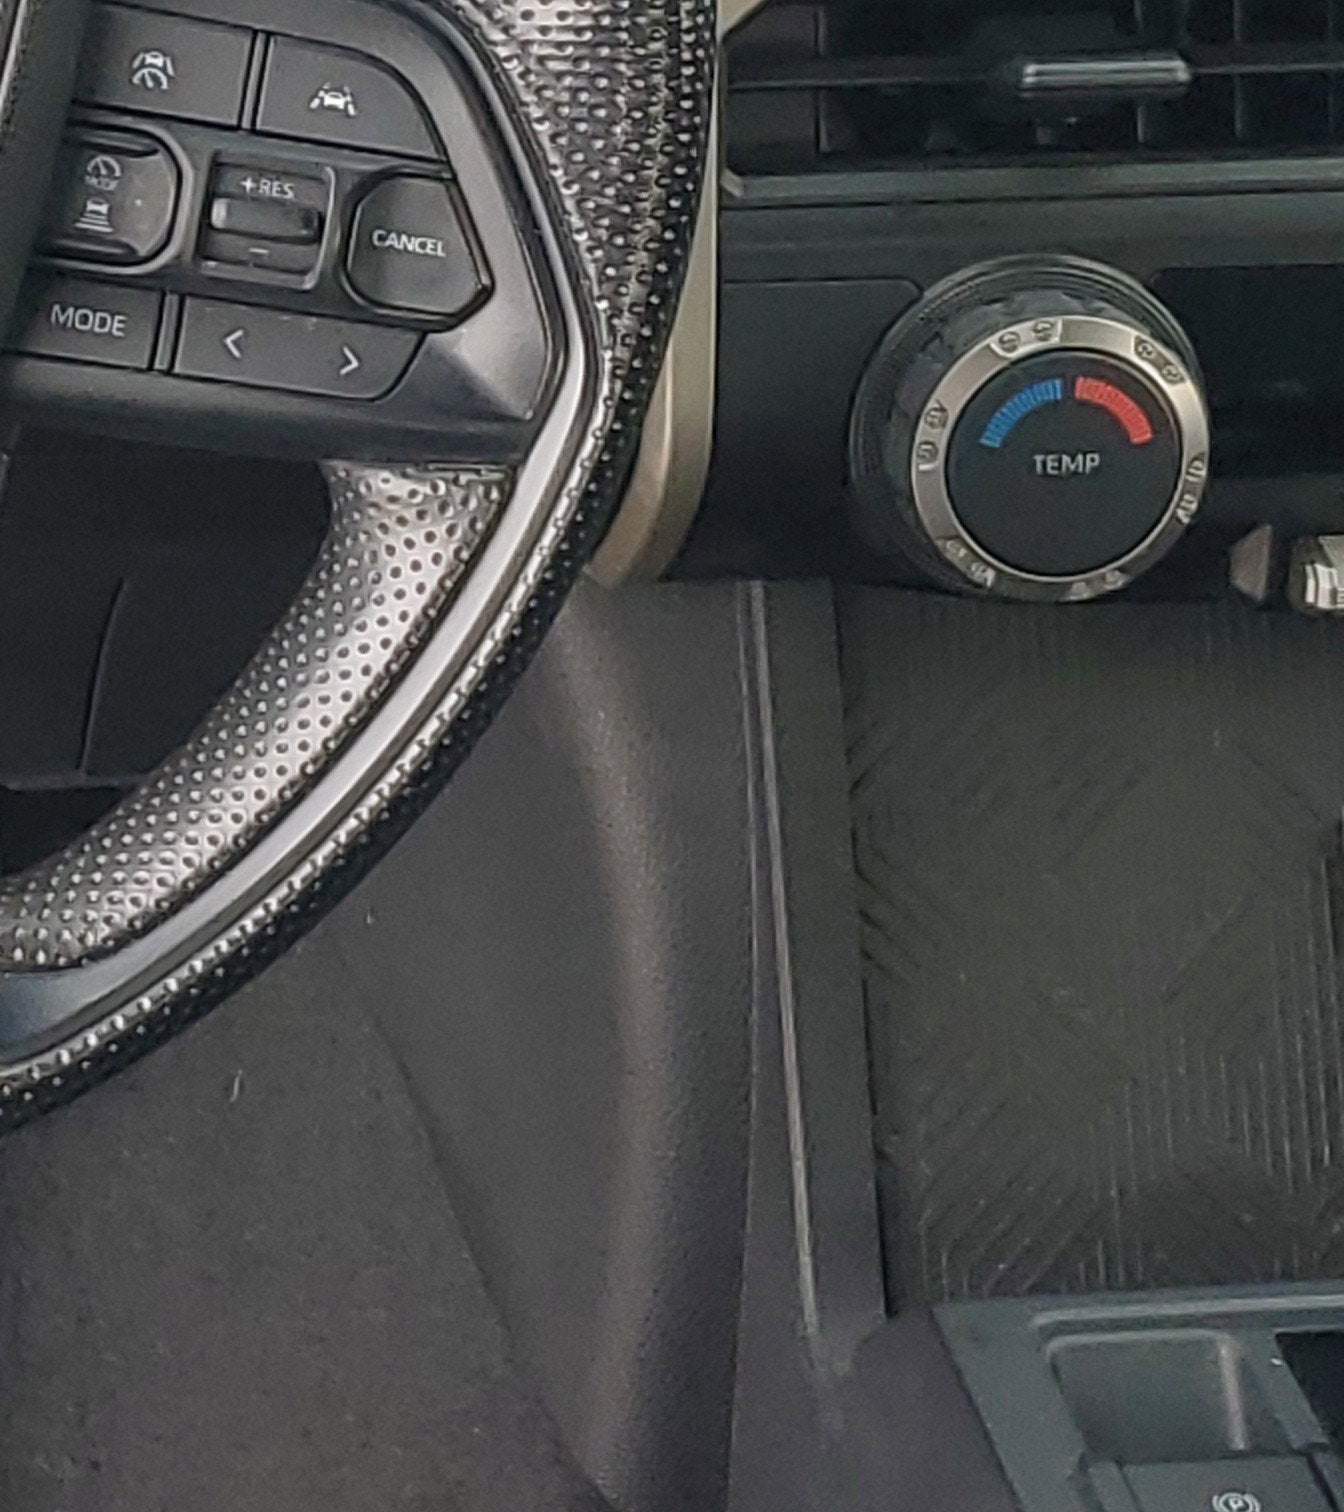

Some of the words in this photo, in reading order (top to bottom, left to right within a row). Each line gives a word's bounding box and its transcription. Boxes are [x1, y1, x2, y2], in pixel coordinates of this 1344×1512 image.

[371, 229, 447, 258] CANCEL
[50, 303, 127, 338] MODE
[1032, 452, 1101, 476] TEMP
